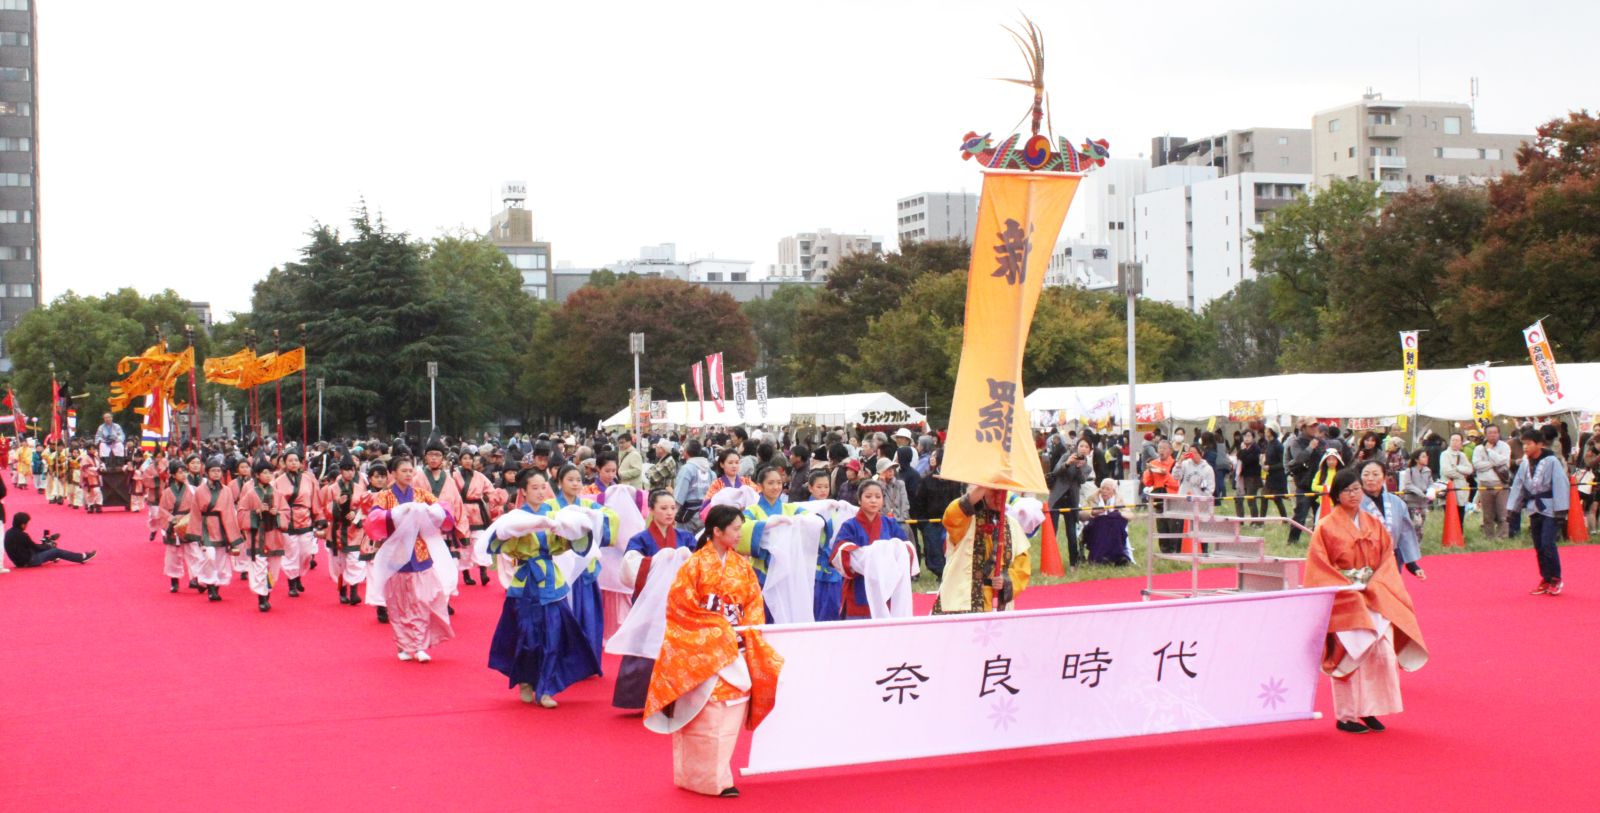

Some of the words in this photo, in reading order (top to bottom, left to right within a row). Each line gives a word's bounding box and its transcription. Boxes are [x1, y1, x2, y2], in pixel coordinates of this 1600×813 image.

[975, 217, 1034, 453] 新羅
[861, 410, 911, 424] フランクフルト
[875, 641, 1198, 705] 奈良時代
